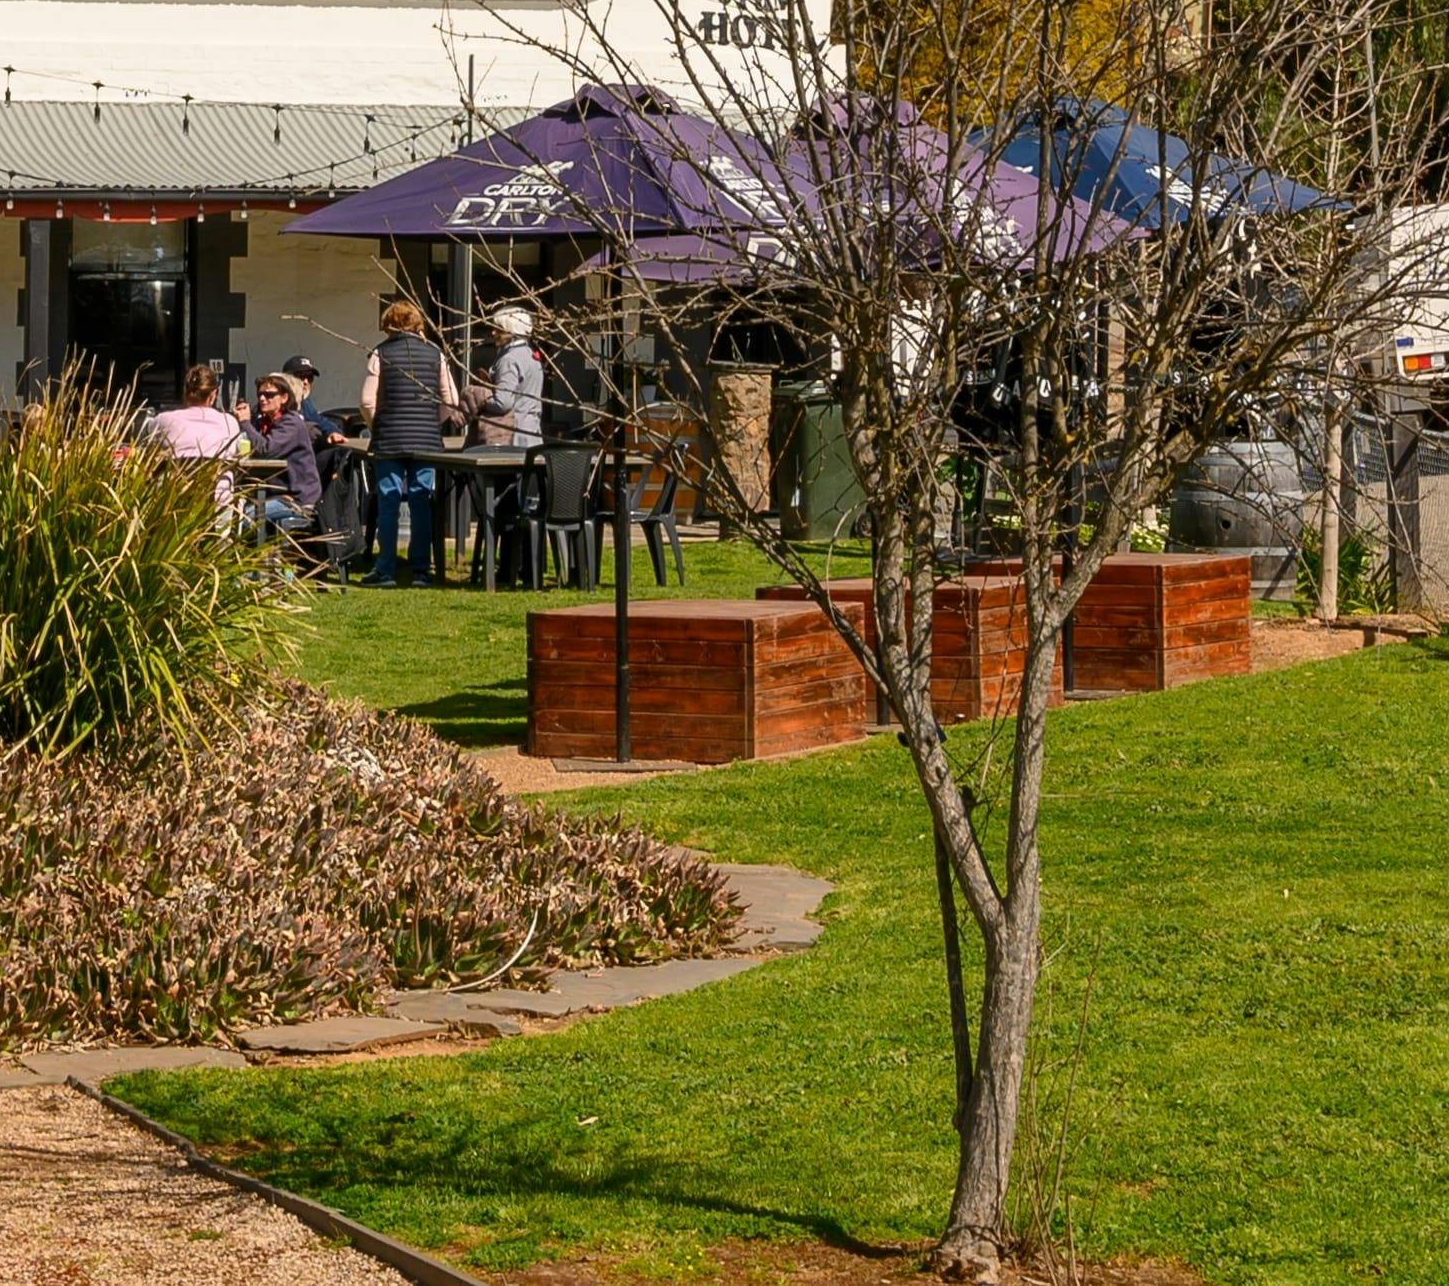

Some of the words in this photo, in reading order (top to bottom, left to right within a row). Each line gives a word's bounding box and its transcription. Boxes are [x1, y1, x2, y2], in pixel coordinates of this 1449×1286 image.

[697, 11, 827, 54] HOTL
[483, 184, 566, 196] CARLTON
[444, 197, 569, 226] DRY
